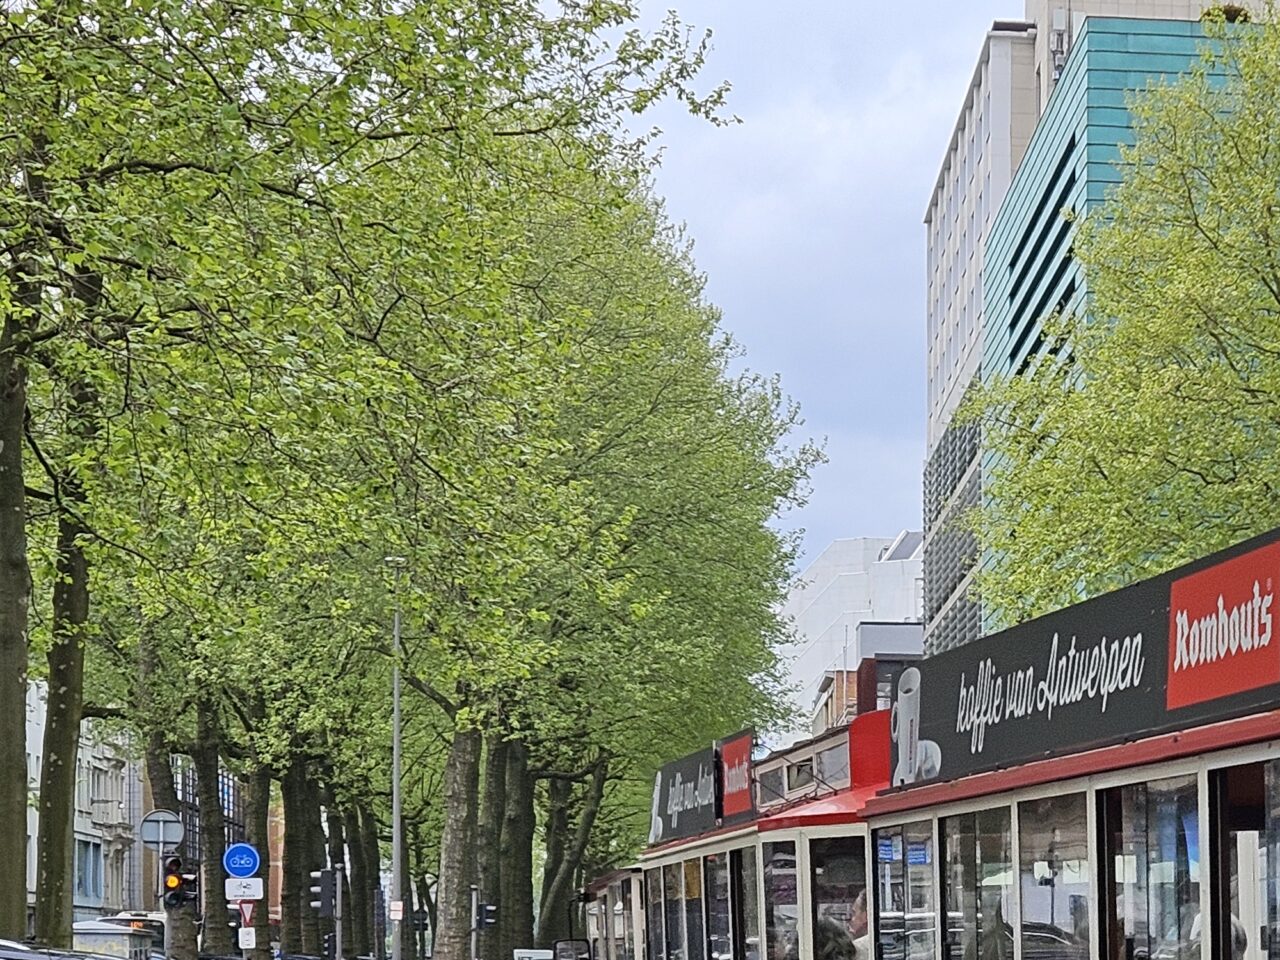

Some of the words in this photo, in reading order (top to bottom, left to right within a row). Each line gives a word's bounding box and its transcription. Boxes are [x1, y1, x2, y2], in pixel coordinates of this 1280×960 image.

[1173, 579, 1274, 672] Rombouts
[955, 657, 1004, 755] koffie
[1005, 663, 1037, 721] van
[1036, 631, 1145, 721] Antwerpen
